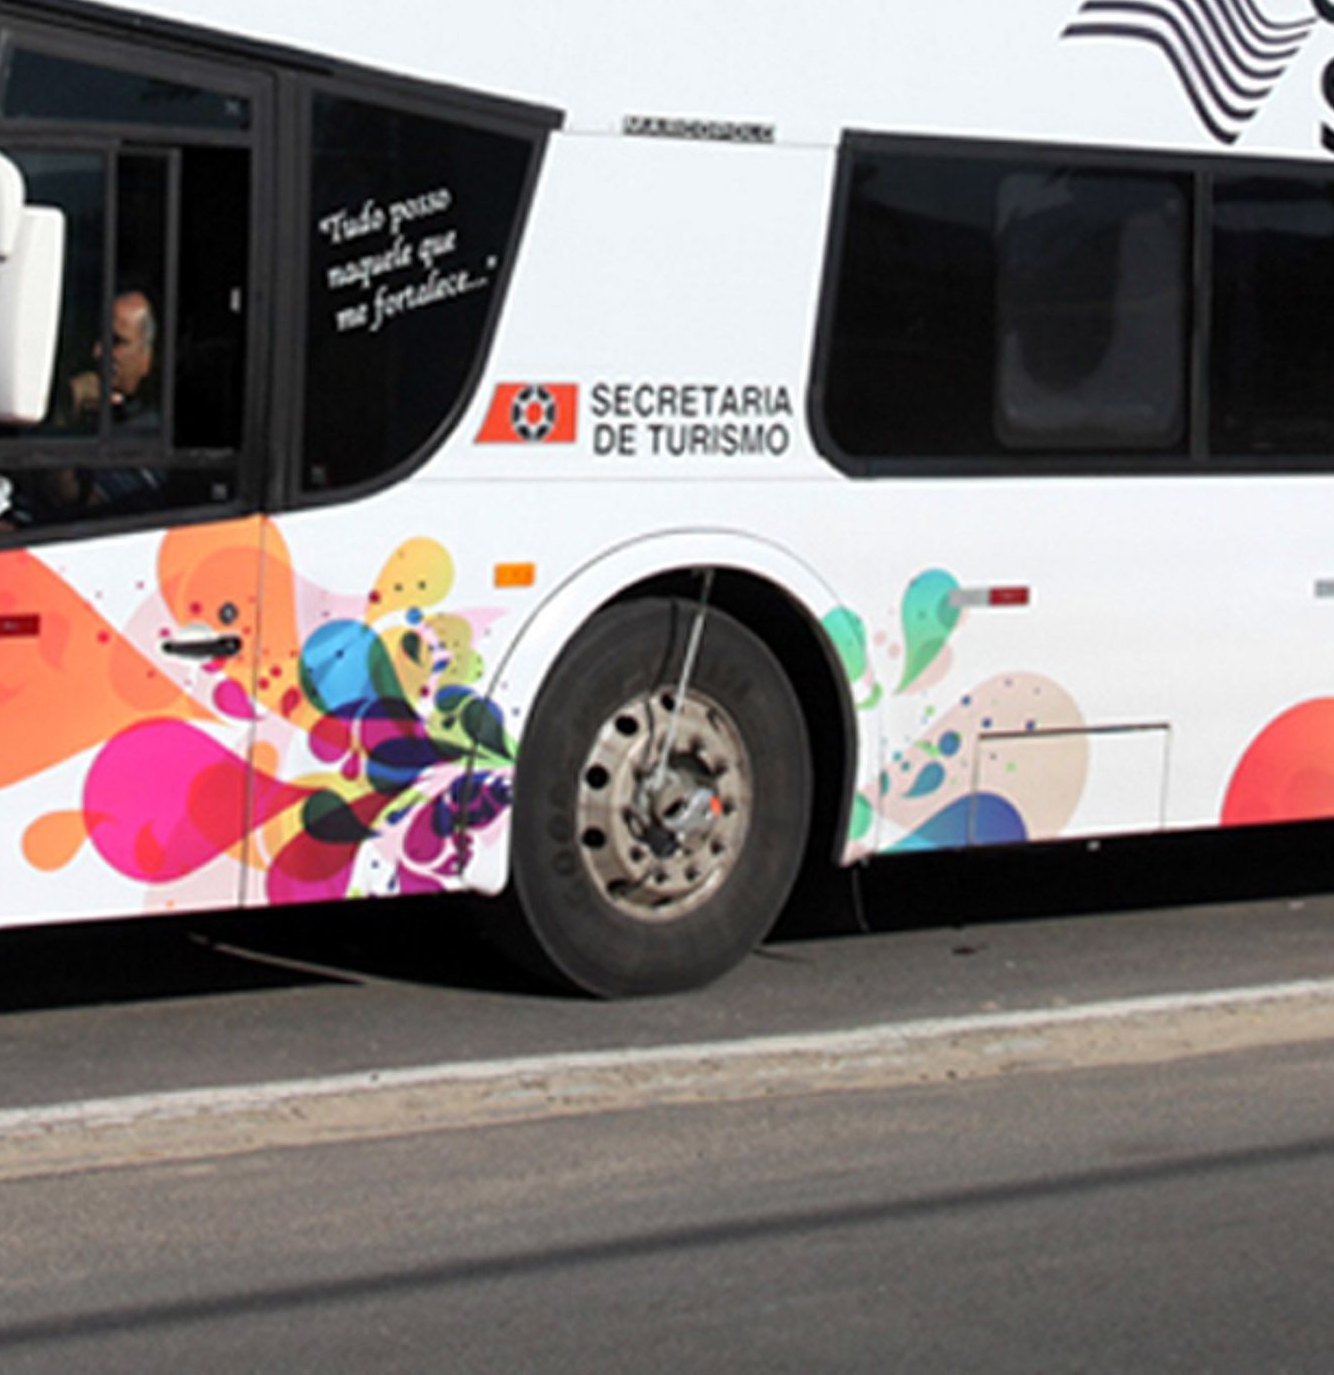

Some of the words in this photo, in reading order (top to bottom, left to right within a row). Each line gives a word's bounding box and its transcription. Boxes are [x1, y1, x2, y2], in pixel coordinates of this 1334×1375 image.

[388, 188, 453, 236] posso
[327, 234, 413, 289] naquele
[418, 229, 457, 269] que
[335, 303, 368, 332] me
[590, 382, 793, 418] SECRETARIA
[592, 424, 638, 456] DE
[646, 424, 791, 457] TURISMO
